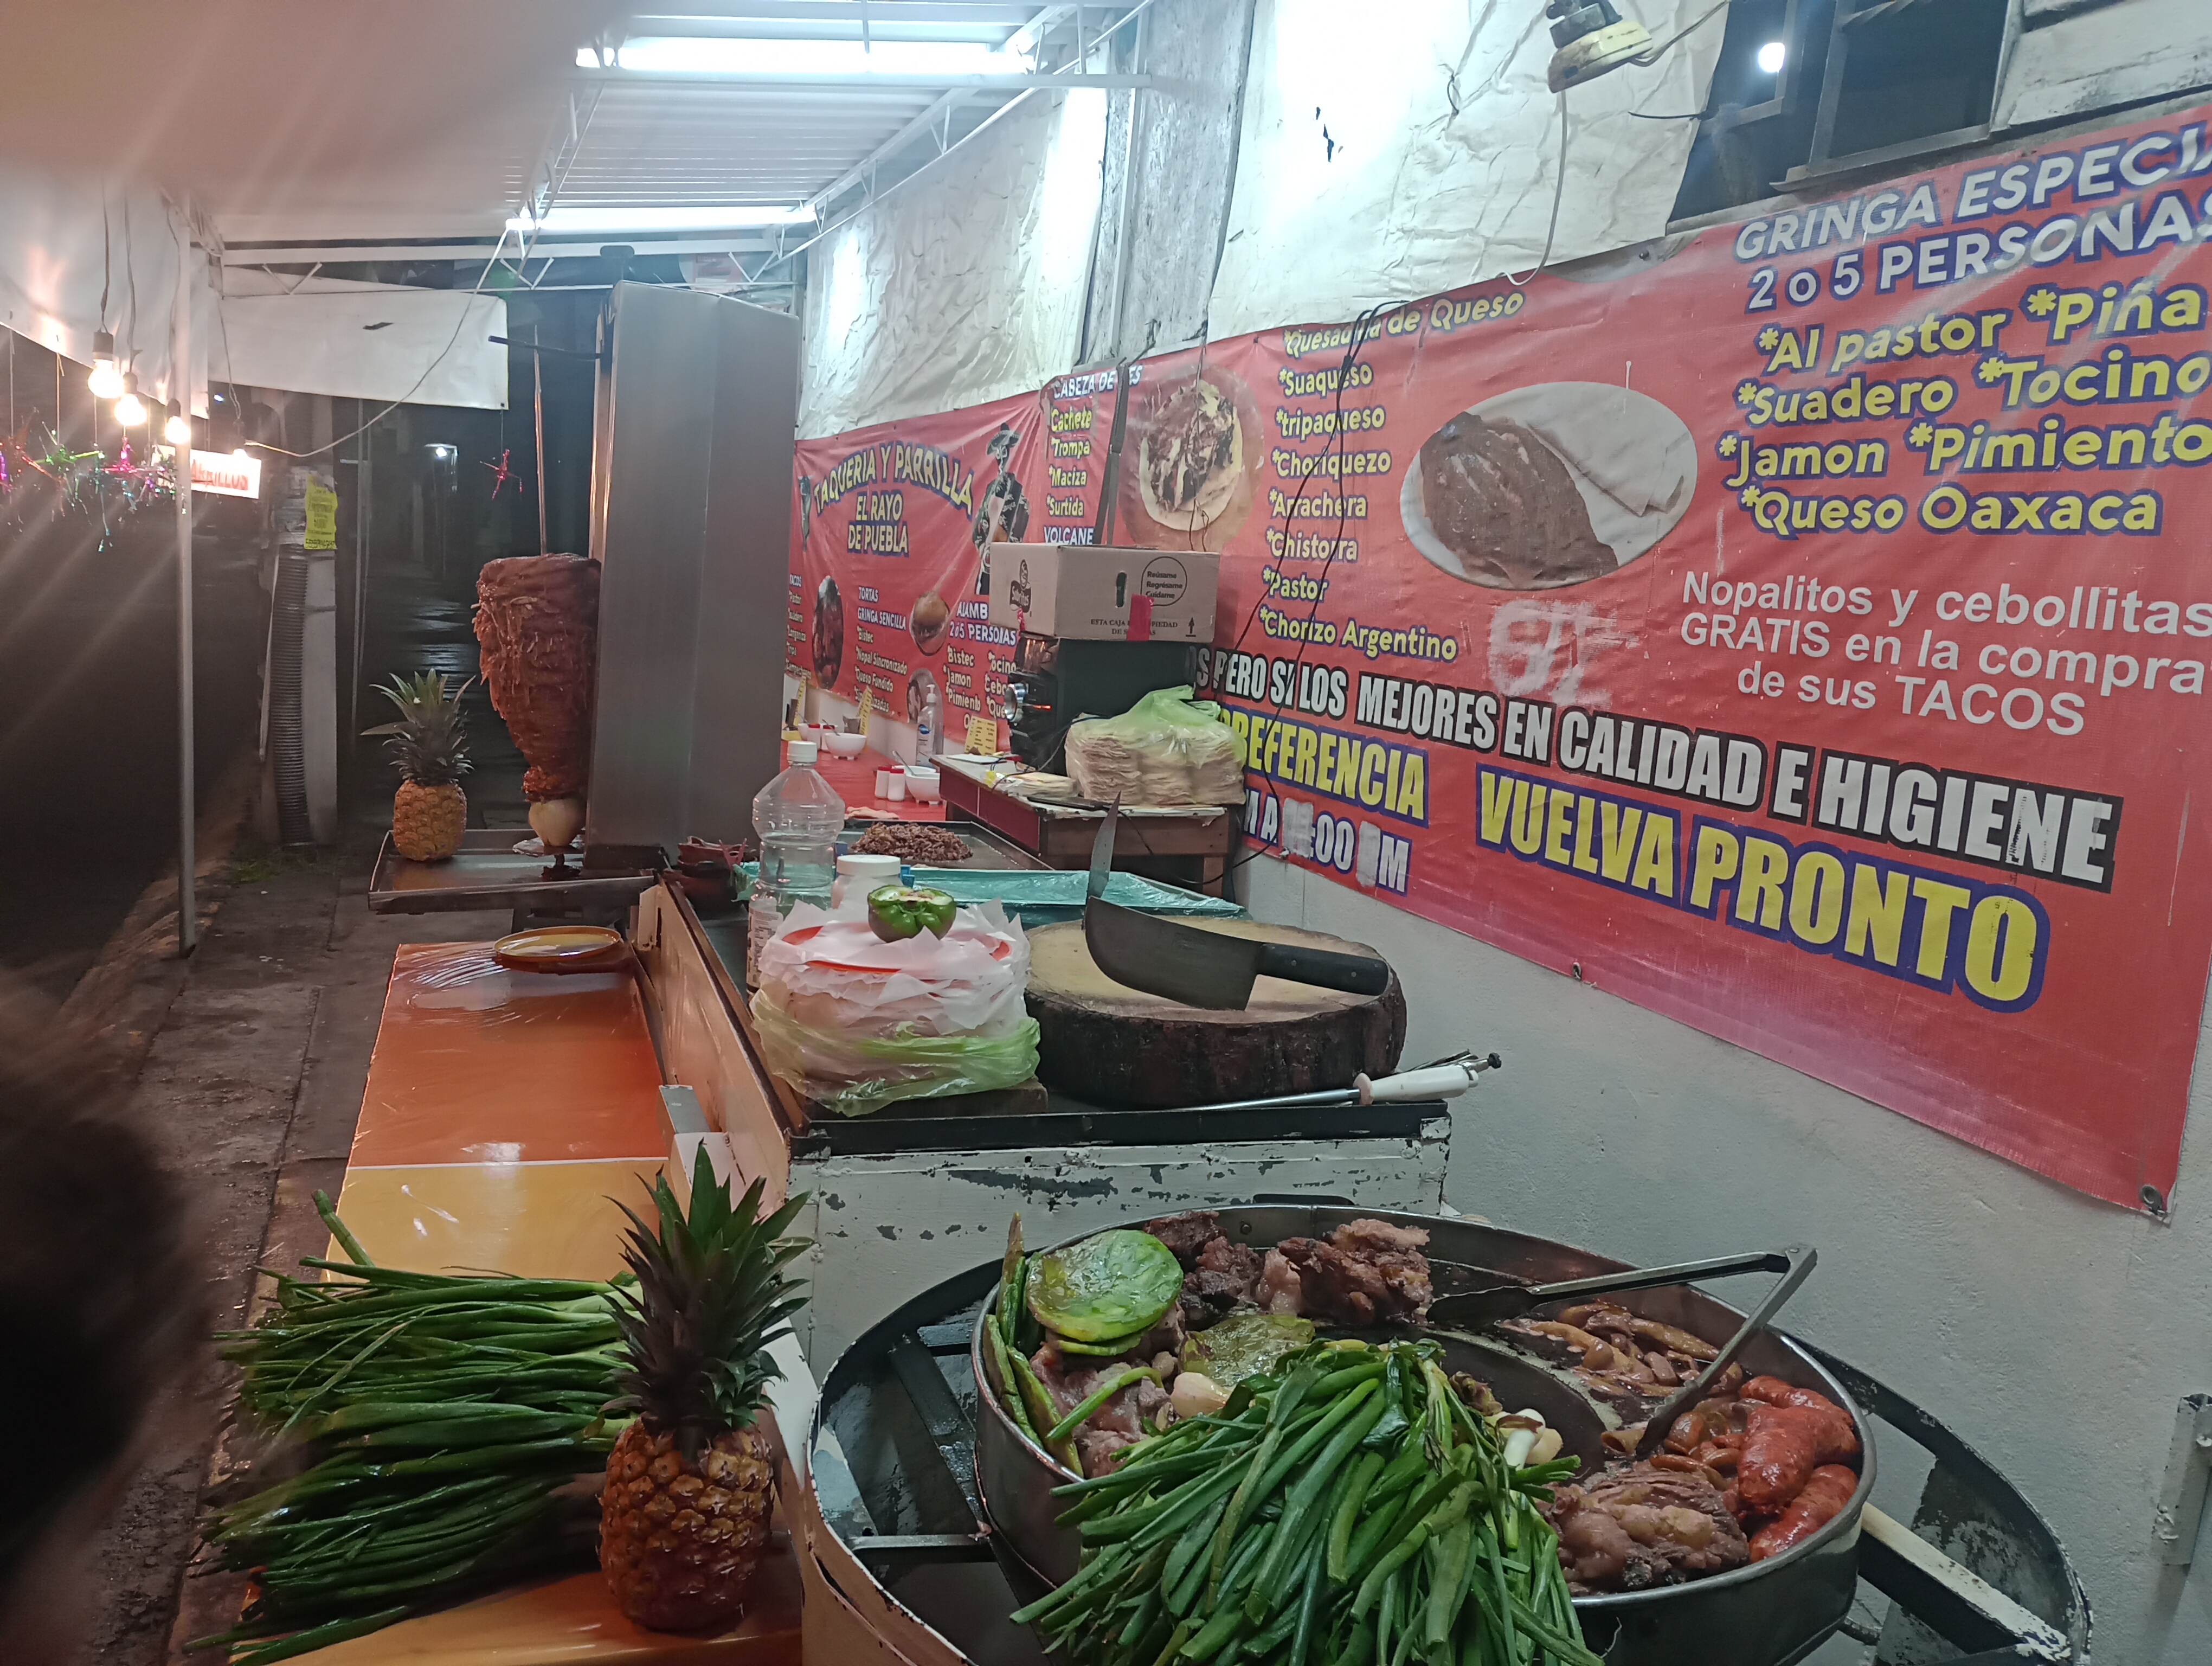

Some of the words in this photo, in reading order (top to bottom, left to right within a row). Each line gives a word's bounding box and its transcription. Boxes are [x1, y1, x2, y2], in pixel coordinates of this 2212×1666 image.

[1737, 185, 1935, 259] GRINGA
[1749, 270, 1775, 309] 2
[1789, 272, 1817, 302] o
[1834, 254, 1860, 296] 5
[1387, 307, 1420, 334] de
[1431, 292, 1525, 330] Queso
[1831, 312, 2007, 371] pastor
[1053, 374, 1095, 399] CABEZA
[1098, 370, 1117, 392] DE
[1129, 365, 1143, 386] ES
[1051, 405, 1092, 432] Cachete
[814, 449, 876, 514] TAQUERIA
[880, 445, 891, 479] Y
[895, 445, 974, 516] PARRILLA
[856, 495, 867, 521] EL
[871, 493, 902, 521] RAYO
[1921, 486, 2157, 530] Oaxaca
[848, 524, 862, 550] DE
[864, 525, 908, 553] PUEBLA
[1044, 526, 1094, 545] VOLCANE
[858, 586, 879, 603] TORTAS
[1146, 580, 1184, 590] Regrésame
[1147, 571, 1178, 579] Reúsame
[857, 606, 878, 624] GRINGA
[879, 611, 907, 630] SENCILLA
[1683, 571, 1873, 615] Nopalitos
[1888, 588, 1919, 627] y
[1936, 583, 2212, 637] cebollitas
[1342, 620, 1457, 661] Argentino
[1680, 612, 1830, 658] GRATIS
[1846, 633, 1901, 665] en
[1917, 629, 1959, 671] la
[1978, 643, 2205, 697] compra
[872, 673, 894, 693] Fundido
[873, 652, 908, 675] Sincronizado
[1737, 660, 1786, 697] de
[1798, 675, 1876, 710] sus
[1895, 675, 2086, 736] TACOS
[1213, 650, 1267, 700] PERO
[1299, 665, 1347, 717] LOS
[1357, 675, 1497, 749] MEJORES
[1503, 701, 1553, 761] EN
[1560, 710, 1762, 807] CALIDAD
[1772, 749, 1809, 818] E
[1818, 755, 2113, 884] HIGIENE
[1481, 771, 1674, 899] VUELVA
[1689, 824, 2037, 1003] PRONTO
